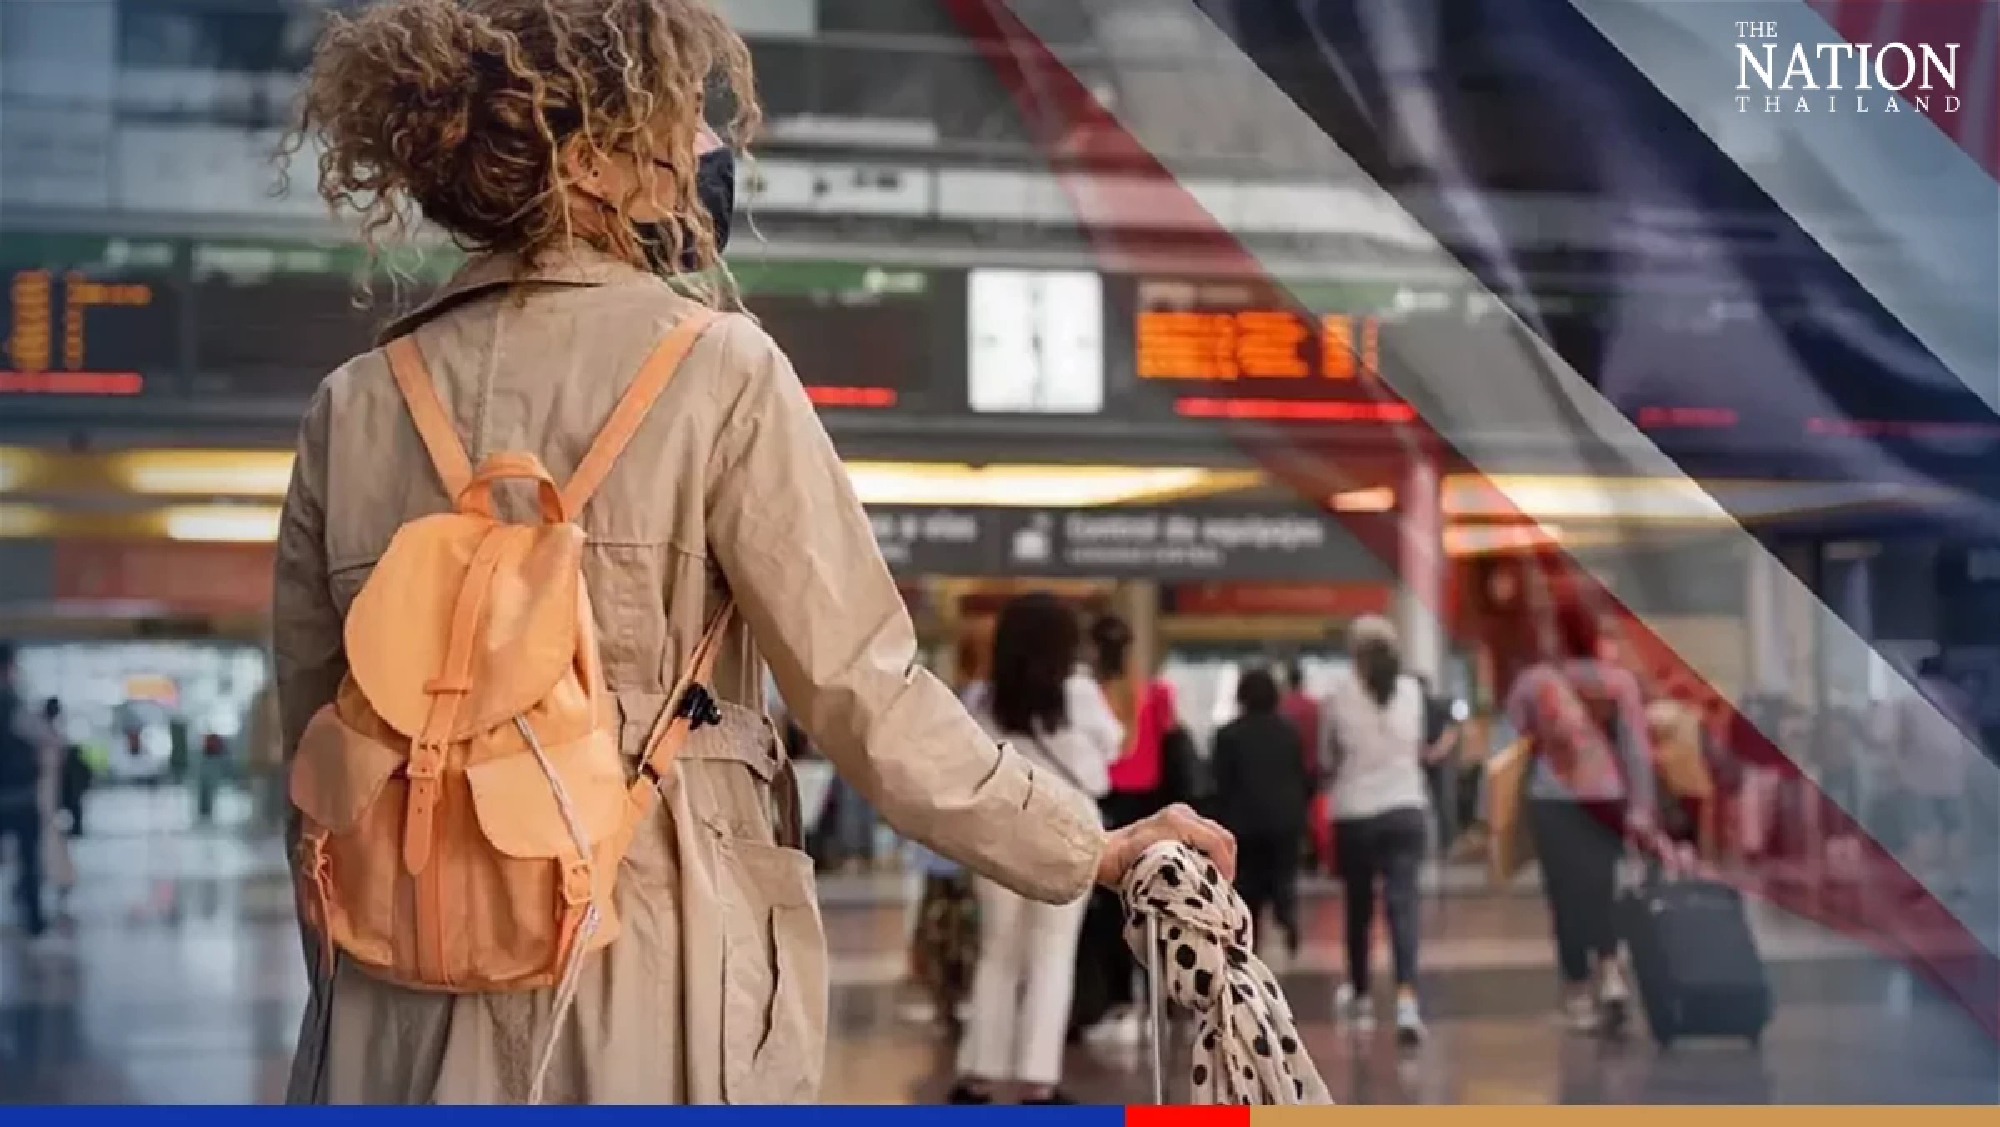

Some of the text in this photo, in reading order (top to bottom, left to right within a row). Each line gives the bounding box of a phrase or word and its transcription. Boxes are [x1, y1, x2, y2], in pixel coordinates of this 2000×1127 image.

[1065, 514, 1324, 549] Control de equipajes
